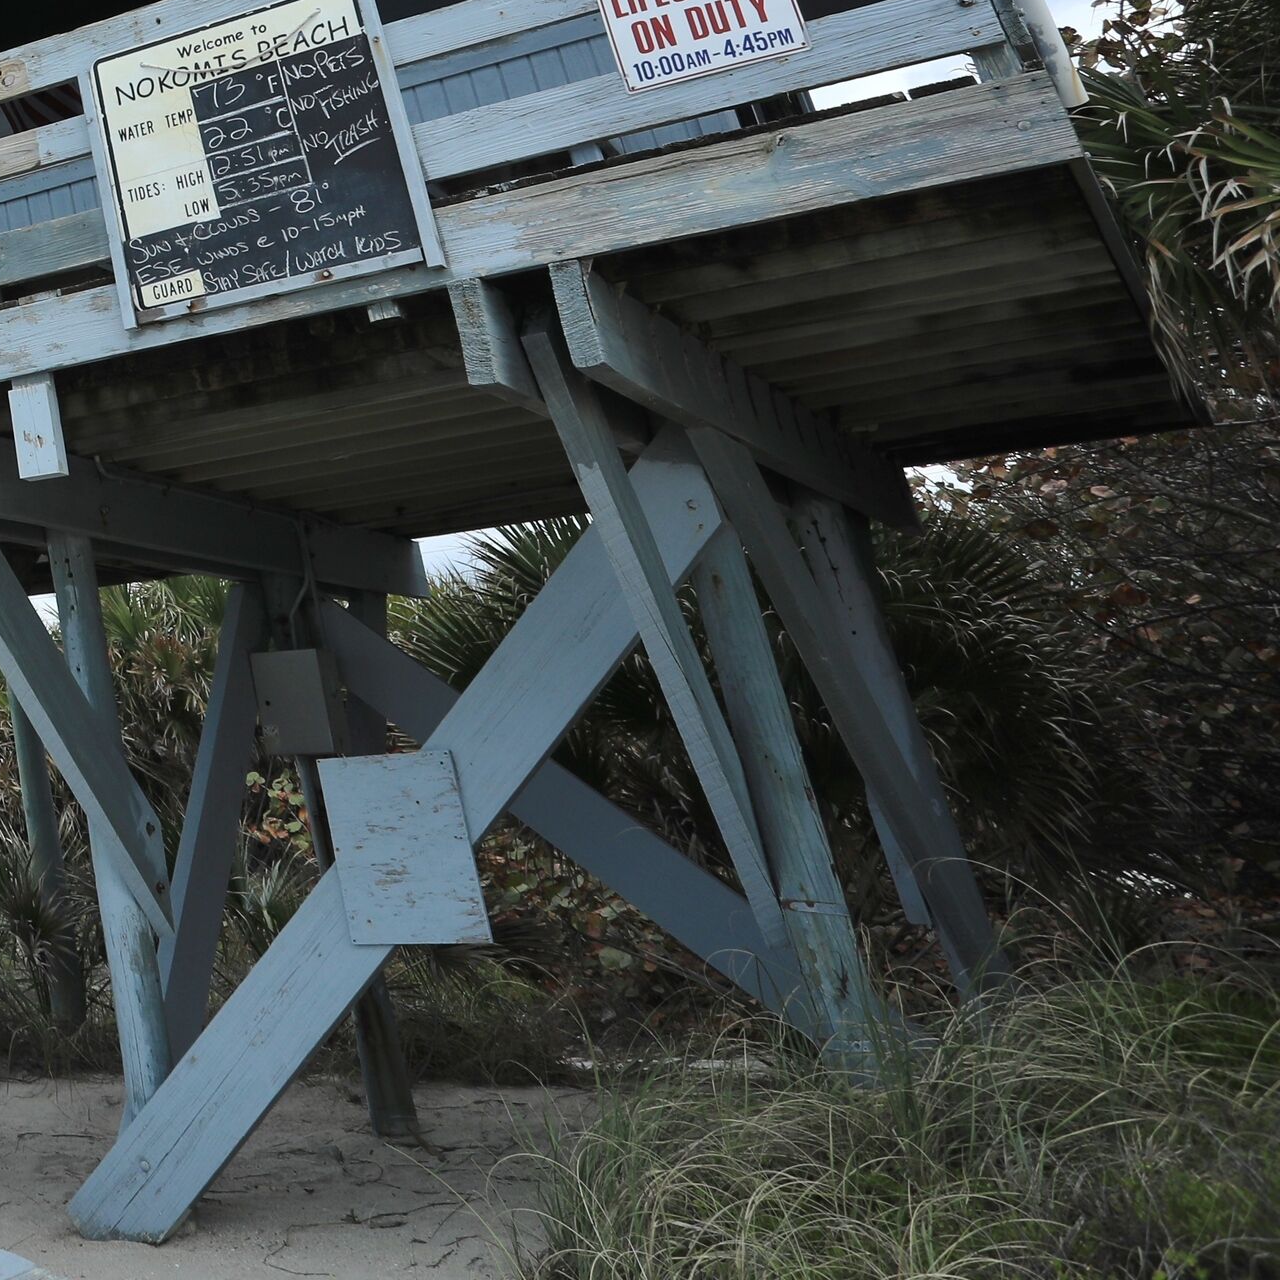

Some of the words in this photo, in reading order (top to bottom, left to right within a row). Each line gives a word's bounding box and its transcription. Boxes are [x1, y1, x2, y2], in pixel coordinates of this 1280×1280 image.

[176, 32, 244, 59] Welcome
[251, 23, 267, 42] to
[631, 14, 677, 54] ON
[115, 49, 248, 105] NOKOMIS
[257, 17, 350, 62] BEACH
[283, 63, 316, 85] NO
[193, 77, 246, 108] 73
[291, 95, 315, 115] NO
[118, 121, 155, 142] WATER
[165, 108, 193, 128] TEMP
[204, 117, 252, 148] 22
[302, 131, 328, 152] NO
[209, 147, 263, 180] 12:51
[128, 183, 165, 203] TIDES:
[176, 170, 204, 190] HIGH
[185, 199, 210, 217] LOW
[129, 238, 171, 264] SUN
[193, 209, 261, 240] CLOUDS
[136, 258, 194, 285] ESE
[196, 242, 249, 266] WINDS
[153, 278, 193, 300] GUARD
[203, 269, 239, 293] STAY
